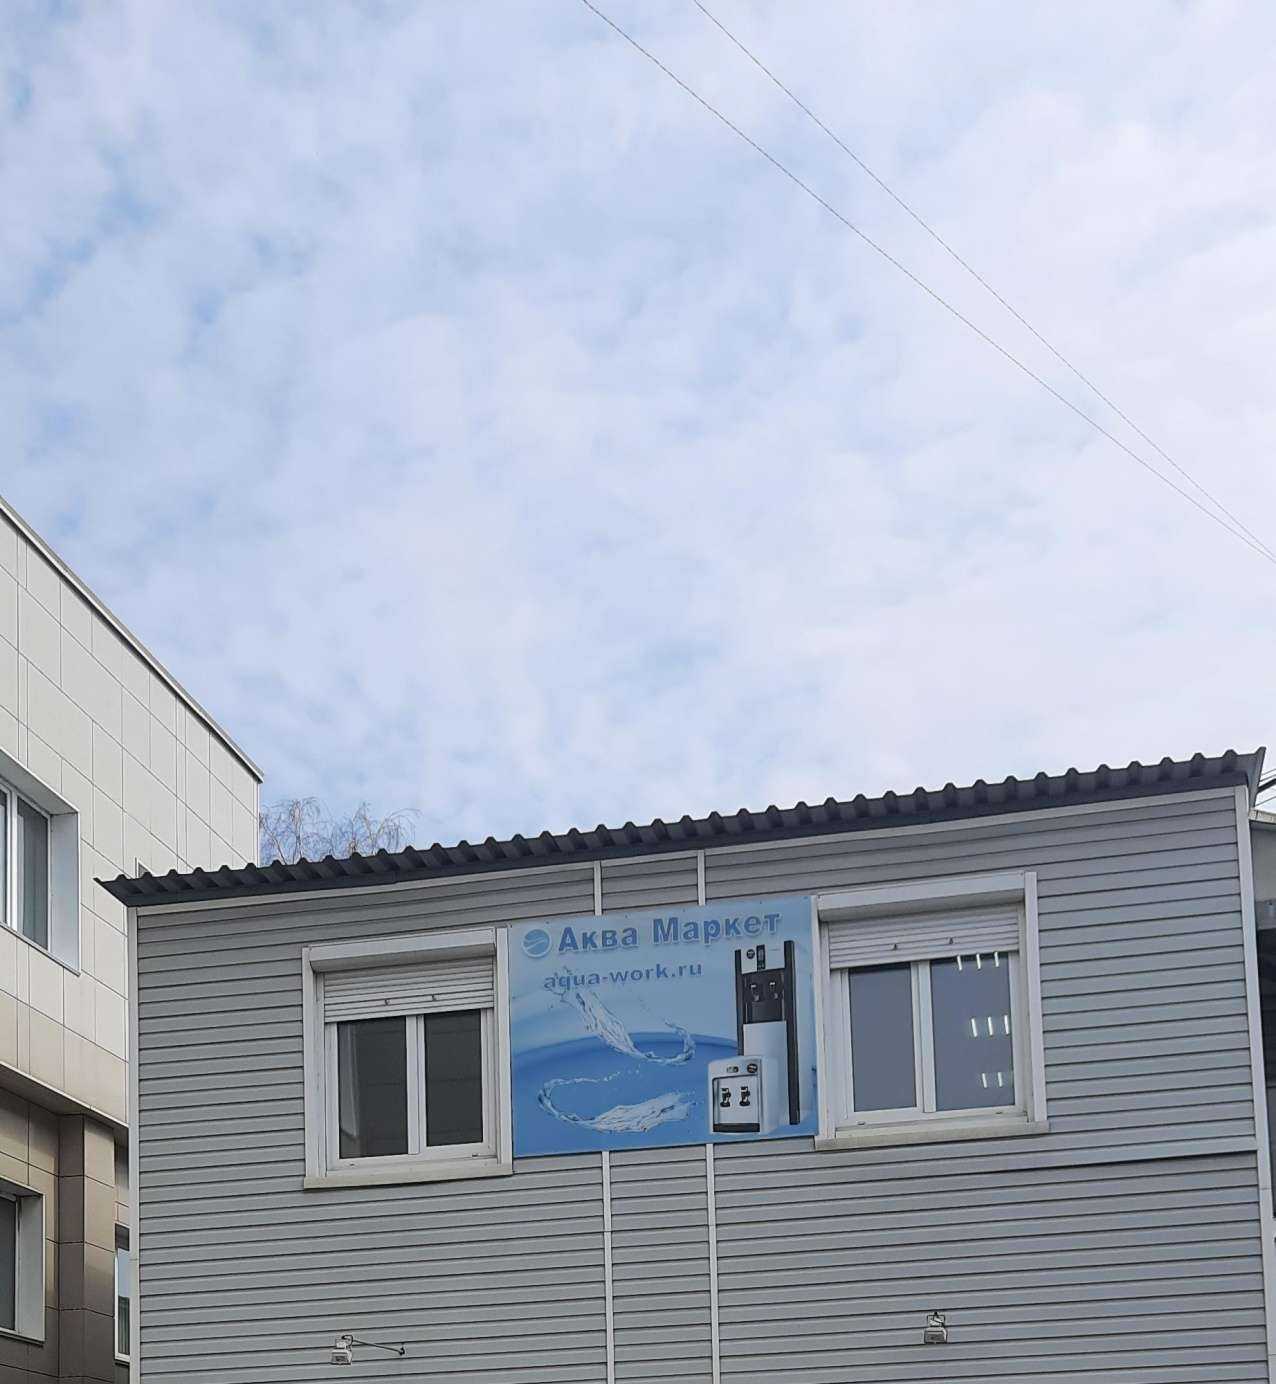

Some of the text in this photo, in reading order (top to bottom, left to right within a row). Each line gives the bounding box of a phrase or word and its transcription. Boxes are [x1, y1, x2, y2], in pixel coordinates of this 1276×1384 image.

[558, 912, 782, 953] Аква Маркет
[543, 963, 702, 991] aqua-work.ru
